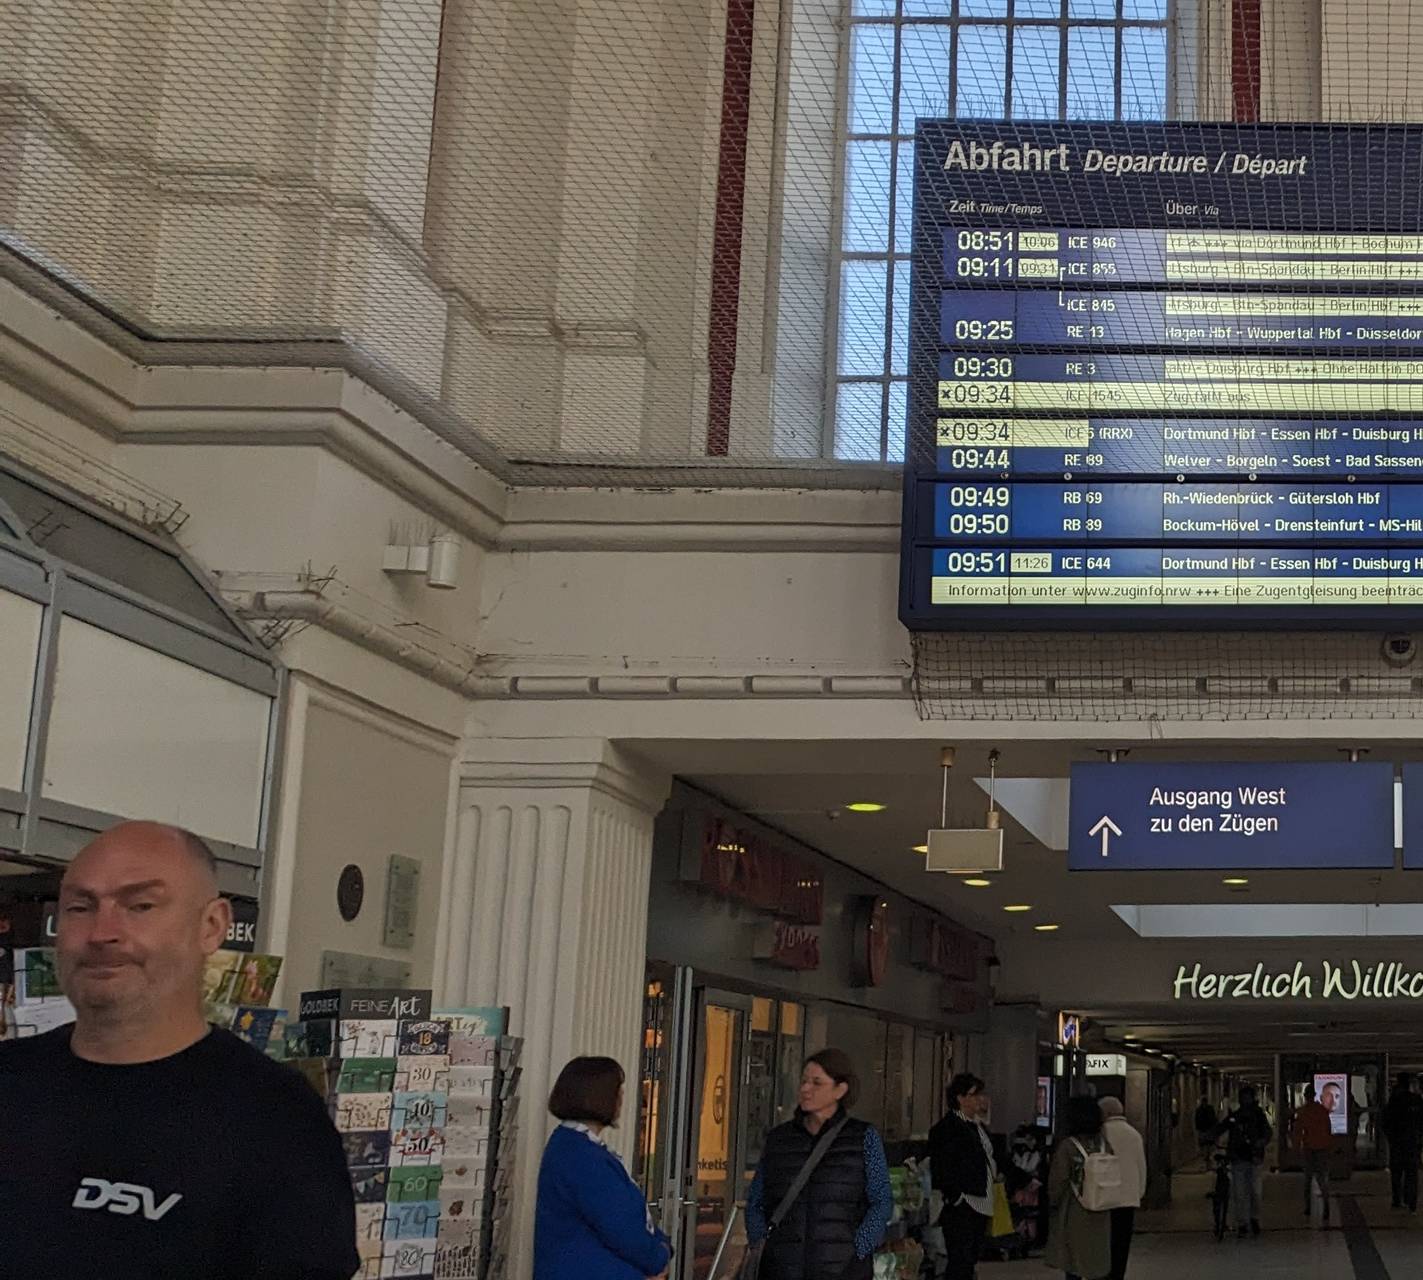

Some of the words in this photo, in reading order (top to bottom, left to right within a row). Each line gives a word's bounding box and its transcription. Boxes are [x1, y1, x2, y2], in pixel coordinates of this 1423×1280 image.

[944, 140, 1069, 172] Abfahrt
[1084, 149, 1206, 177] Departure
[1232, 152, 1307, 179] Départ
[949, 201, 975, 213] Zeit
[1166, 200, 1198, 215] Über
[1204, 205, 1219, 216] Via
[958, 231, 1014, 251] 08:51
[1068, 237, 1087, 249] ICE
[1093, 237, 1116, 249] 946
[957, 258, 1013, 277] 09:11
[1068, 263, 1087, 275] ICE
[1067, 300, 1086, 312] ICE
[955, 320, 1013, 340] 09:25
[1067, 326, 1084, 338] RE
[1089, 326, 1104, 338] 13
[1165, 327, 1205, 341] Hagen
[1209, 327, 1232, 339] Hbf
[1247, 328, 1314, 342] Wuppertal
[1319, 328, 1341, 340] Hbf
[954, 357, 1012, 377] 09:30
[1066, 363, 1082, 375] RE
[1087, 363, 1096, 375] 3
[954, 385, 1010, 404] 09:34
[953, 422, 1009, 442] 09:34
[1099, 427, 1133, 441] (RRX)
[1164, 428, 1229, 440] Dortmund
[1233, 428, 1256, 440] Hbf
[1272, 429, 1310, 440] Essen
[1314, 429, 1338, 440] Hbf
[1353, 429, 1409, 443] Duisburg
[952, 449, 1010, 469] 09:44
[1064, 454, 1081, 466] RE
[1164, 455, 1211, 467] Welver
[1227, 455, 1277, 470] Borgeln
[1293, 455, 1331, 467] Soest
[1346, 455, 1371, 467] Bad
[950, 487, 1009, 507] 09:49
[1064, 492, 1081, 504] RB
[1087, 492, 1103, 504] 69
[1163, 492, 1273, 504] Rh.-Wiedenbrück
[1289, 492, 1354, 505] Gütersloh
[1358, 492, 1381, 505] Hbf
[950, 514, 1009, 534] 09:50
[1063, 519, 1081, 531] RB
[1163, 519, 1260, 532] Bockum-Hövel
[1275, 519, 1365, 532] Drensteinfurt
[948, 552, 1006, 573] 09:51
[1014, 557, 1049, 570] 11:26
[1061, 557, 1082, 570] ICE
[1086, 557, 1111, 570] 644
[1162, 558, 1228, 570] Dortmund
[1232, 558, 1255, 570] Hbf
[1271, 558, 1310, 571] Essen
[1314, 558, 1337, 571] Hbf
[1353, 558, 1411, 573] Duisburg
[949, 585, 1027, 597] Information
[1032, 586, 1067, 597] unter
[1073, 585, 1191, 599] www.zuginfo.nrw
[1224, 585, 1252, 597] Eine
[1256, 585, 1357, 601] Zugentgleisung
[1149, 787, 1233, 810] Ausgang
[1238, 787, 1287, 805] West
[1150, 818, 1172, 832] zu
[1178, 814, 1213, 832] den
[1219, 814, 1278, 836] Zügen
[1173, 961, 1312, 999] Herzlich
[419, 1031, 432, 1045] 18
[413, 1067, 431, 1081] 30
[404, 1176, 428, 1192] 60
[72, 1177, 183, 1221] DSV
